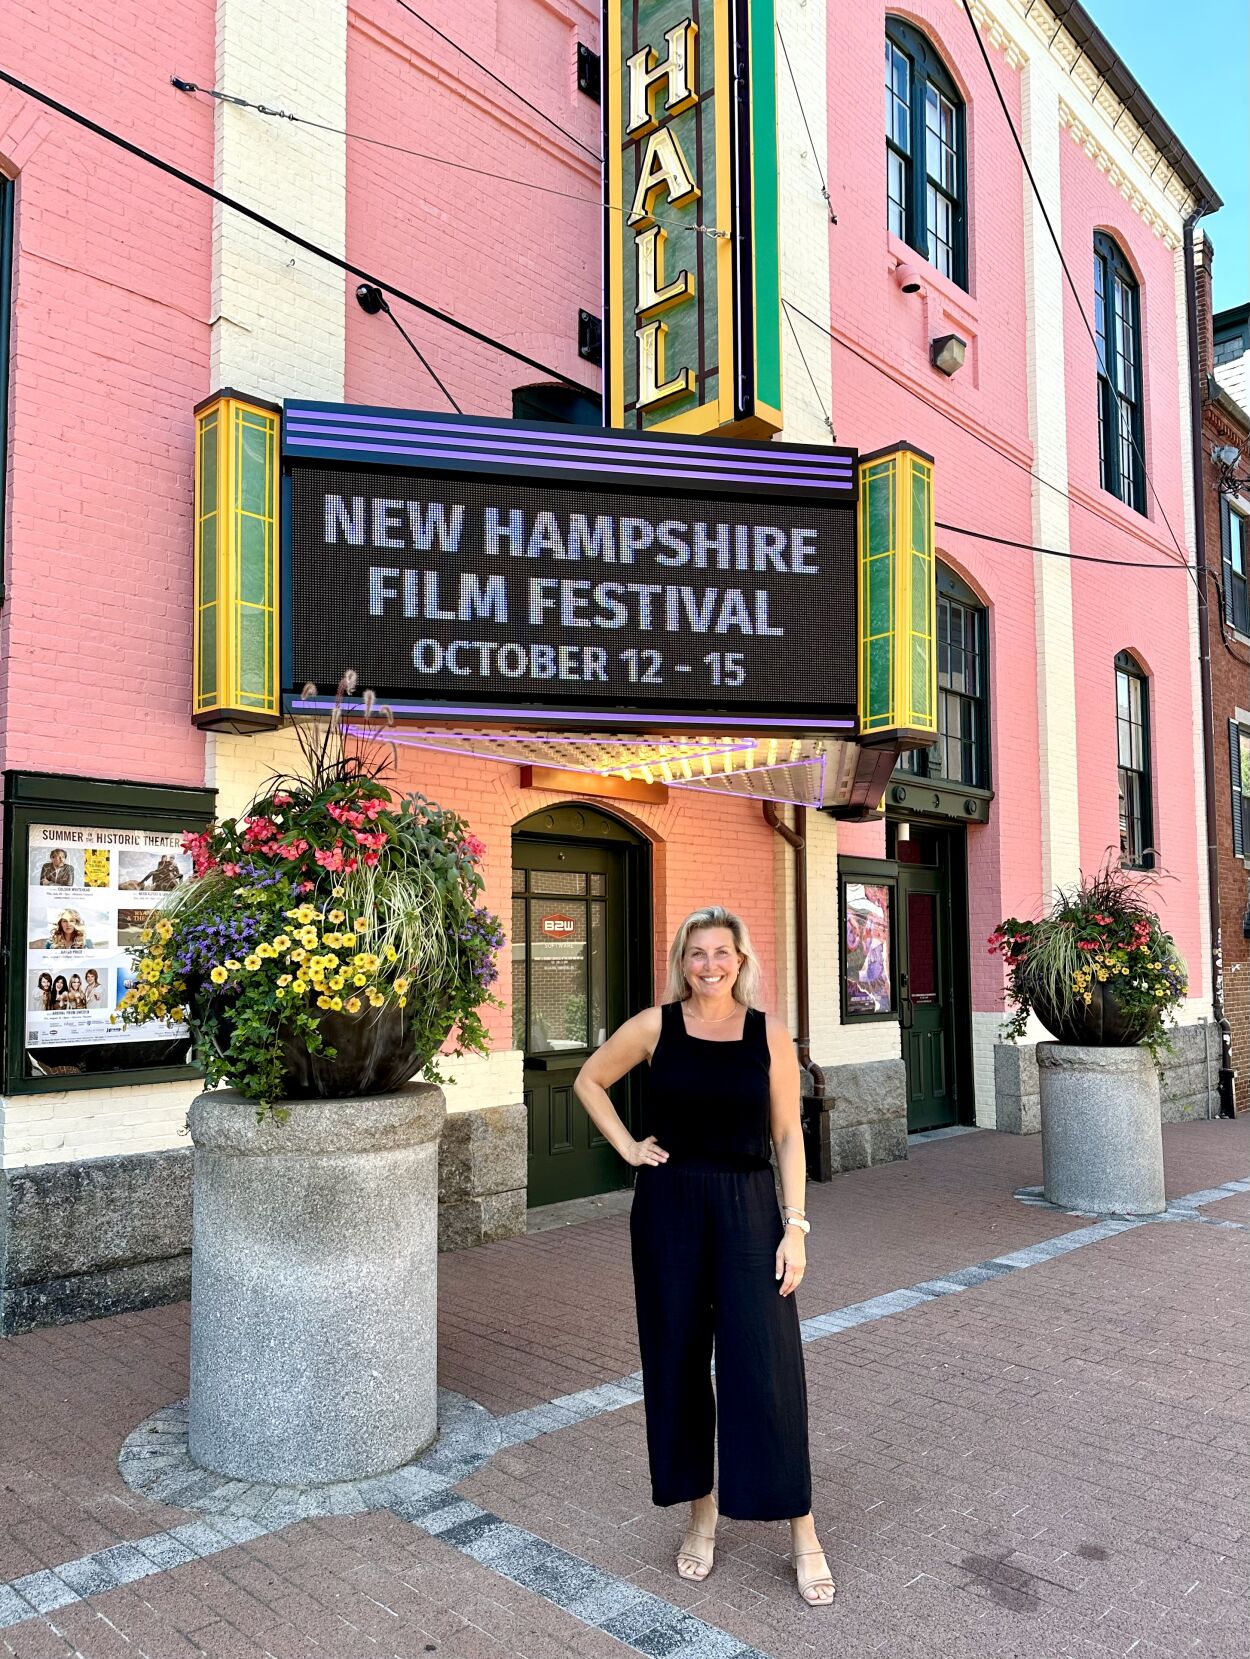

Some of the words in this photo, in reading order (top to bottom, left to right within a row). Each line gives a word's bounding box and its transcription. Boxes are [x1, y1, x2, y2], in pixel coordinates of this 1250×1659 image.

[626, 17, 701, 413] HALL
[323, 493, 466, 554] NEW
[484, 506, 820, 574] HAMPSHIRE
[368, 566, 509, 624] FILM
[529, 577, 785, 637] FESTIVAL
[412, 638, 609, 682] OCTOBER
[618, 648, 664, 684] 12
[703, 652, 748, 688] 15
[42, 829, 84, 843] SUMMER
[96, 832, 140, 846] HISTORIC
[144, 835, 181, 848] THEATER
[544, 920, 574, 931] B2W
